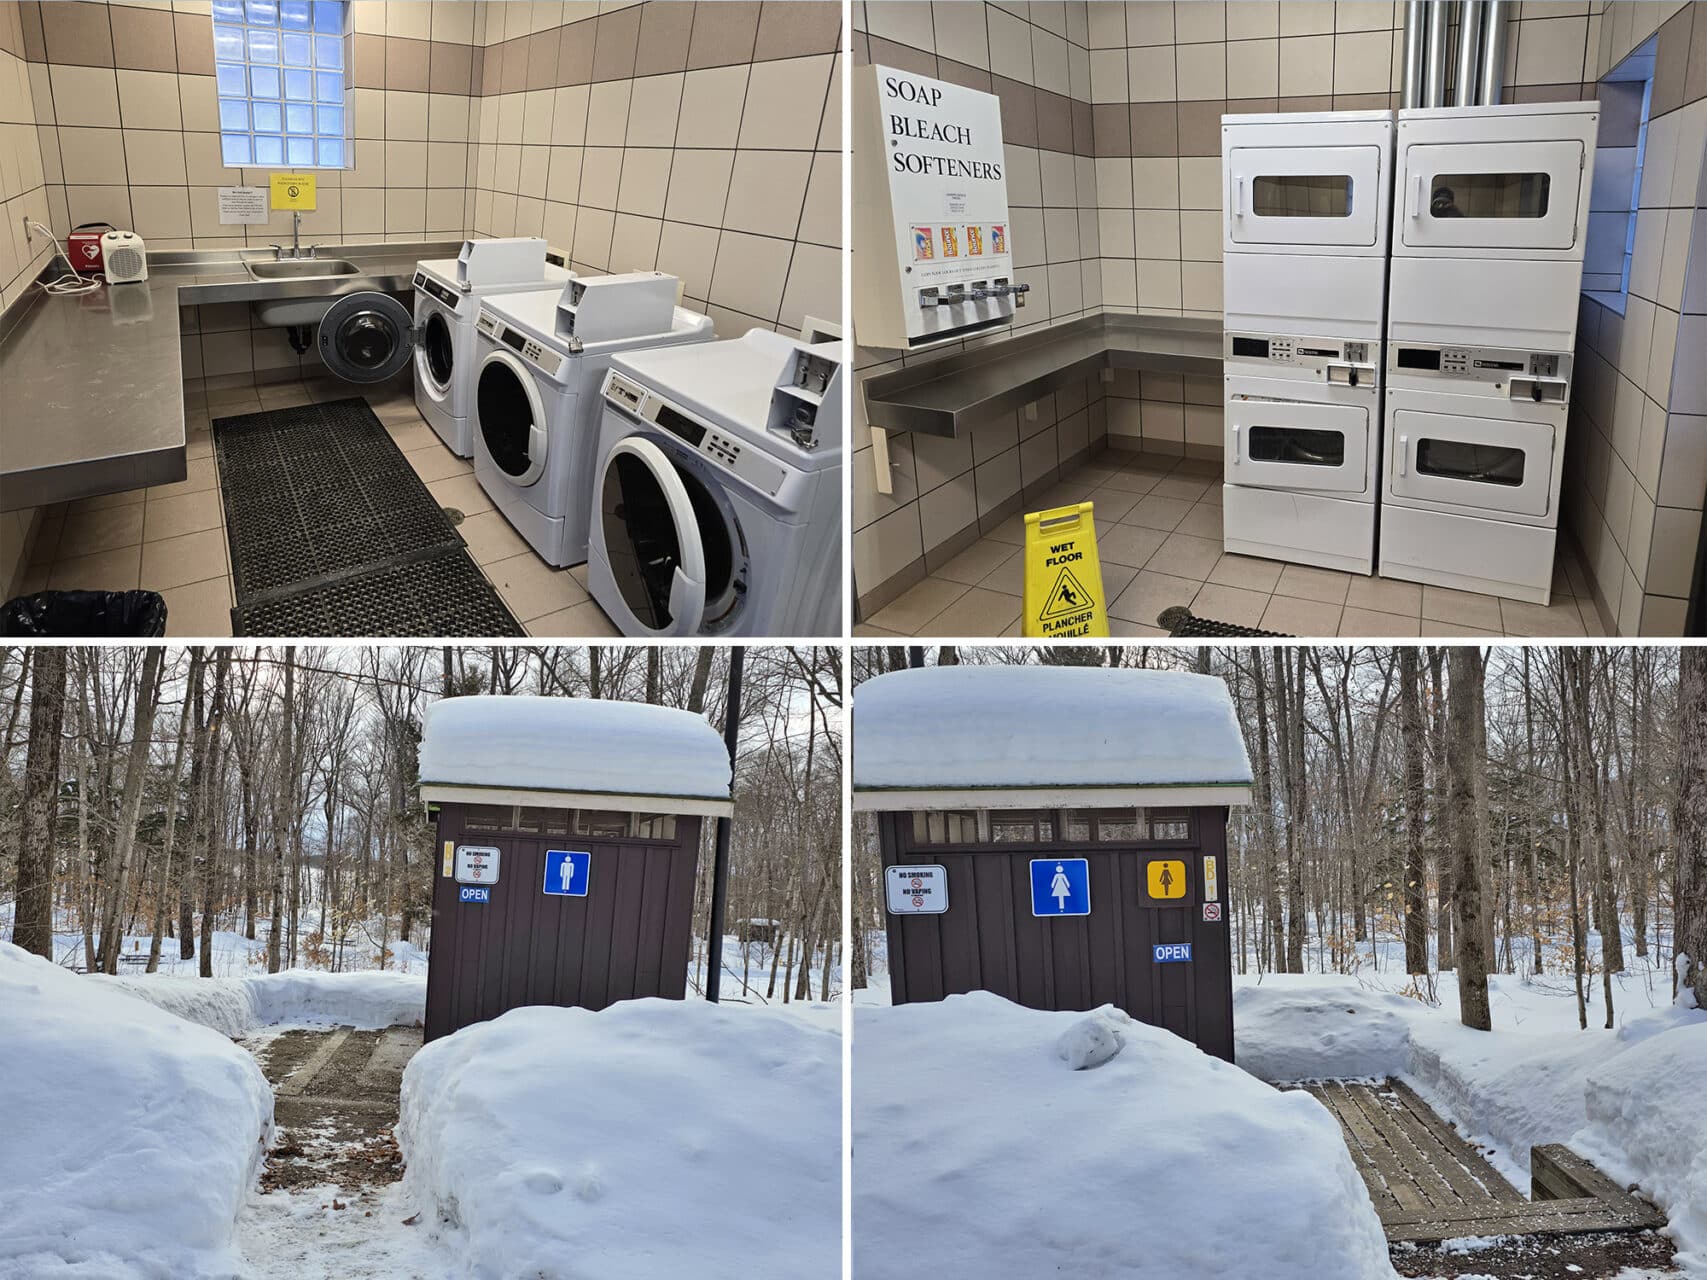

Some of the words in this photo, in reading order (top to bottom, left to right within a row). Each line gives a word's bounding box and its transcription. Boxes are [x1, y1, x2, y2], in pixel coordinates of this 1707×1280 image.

[886, 77, 942, 108] SOAP
[890, 114, 972, 146] BLEACH
[893, 152, 1002, 181] SOFTENERS
[1050, 542, 1075, 554] WET
[1045, 552, 1083, 567] FLOOR
[1043, 611, 1093, 632] PLANCHER
[1048, 623, 1089, 638] OUILLÉ
[461, 888, 488, 900] OPEN
[1155, 945, 1190, 960] OPEN
